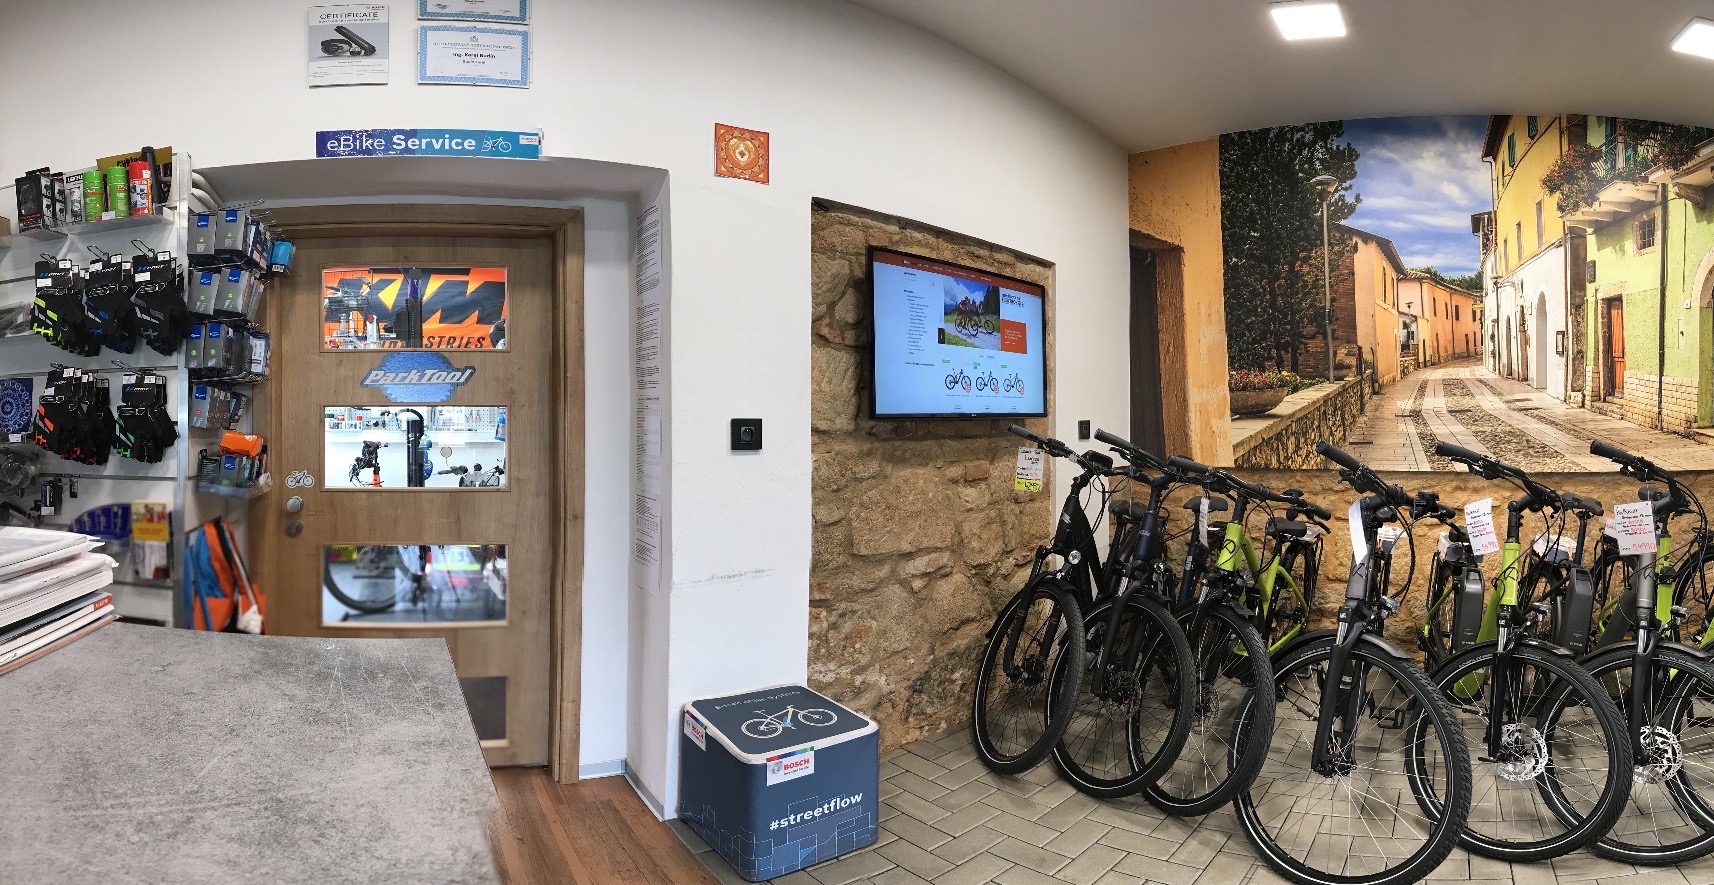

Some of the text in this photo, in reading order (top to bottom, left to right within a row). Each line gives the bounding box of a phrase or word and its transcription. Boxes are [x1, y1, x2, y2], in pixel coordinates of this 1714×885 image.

[320, 11, 379, 20] CERTIFICATE
[327, 134, 476, 151] eBike Service
[783, 758, 810, 771] BOSCH
[769, 792, 863, 831] #streetflow
